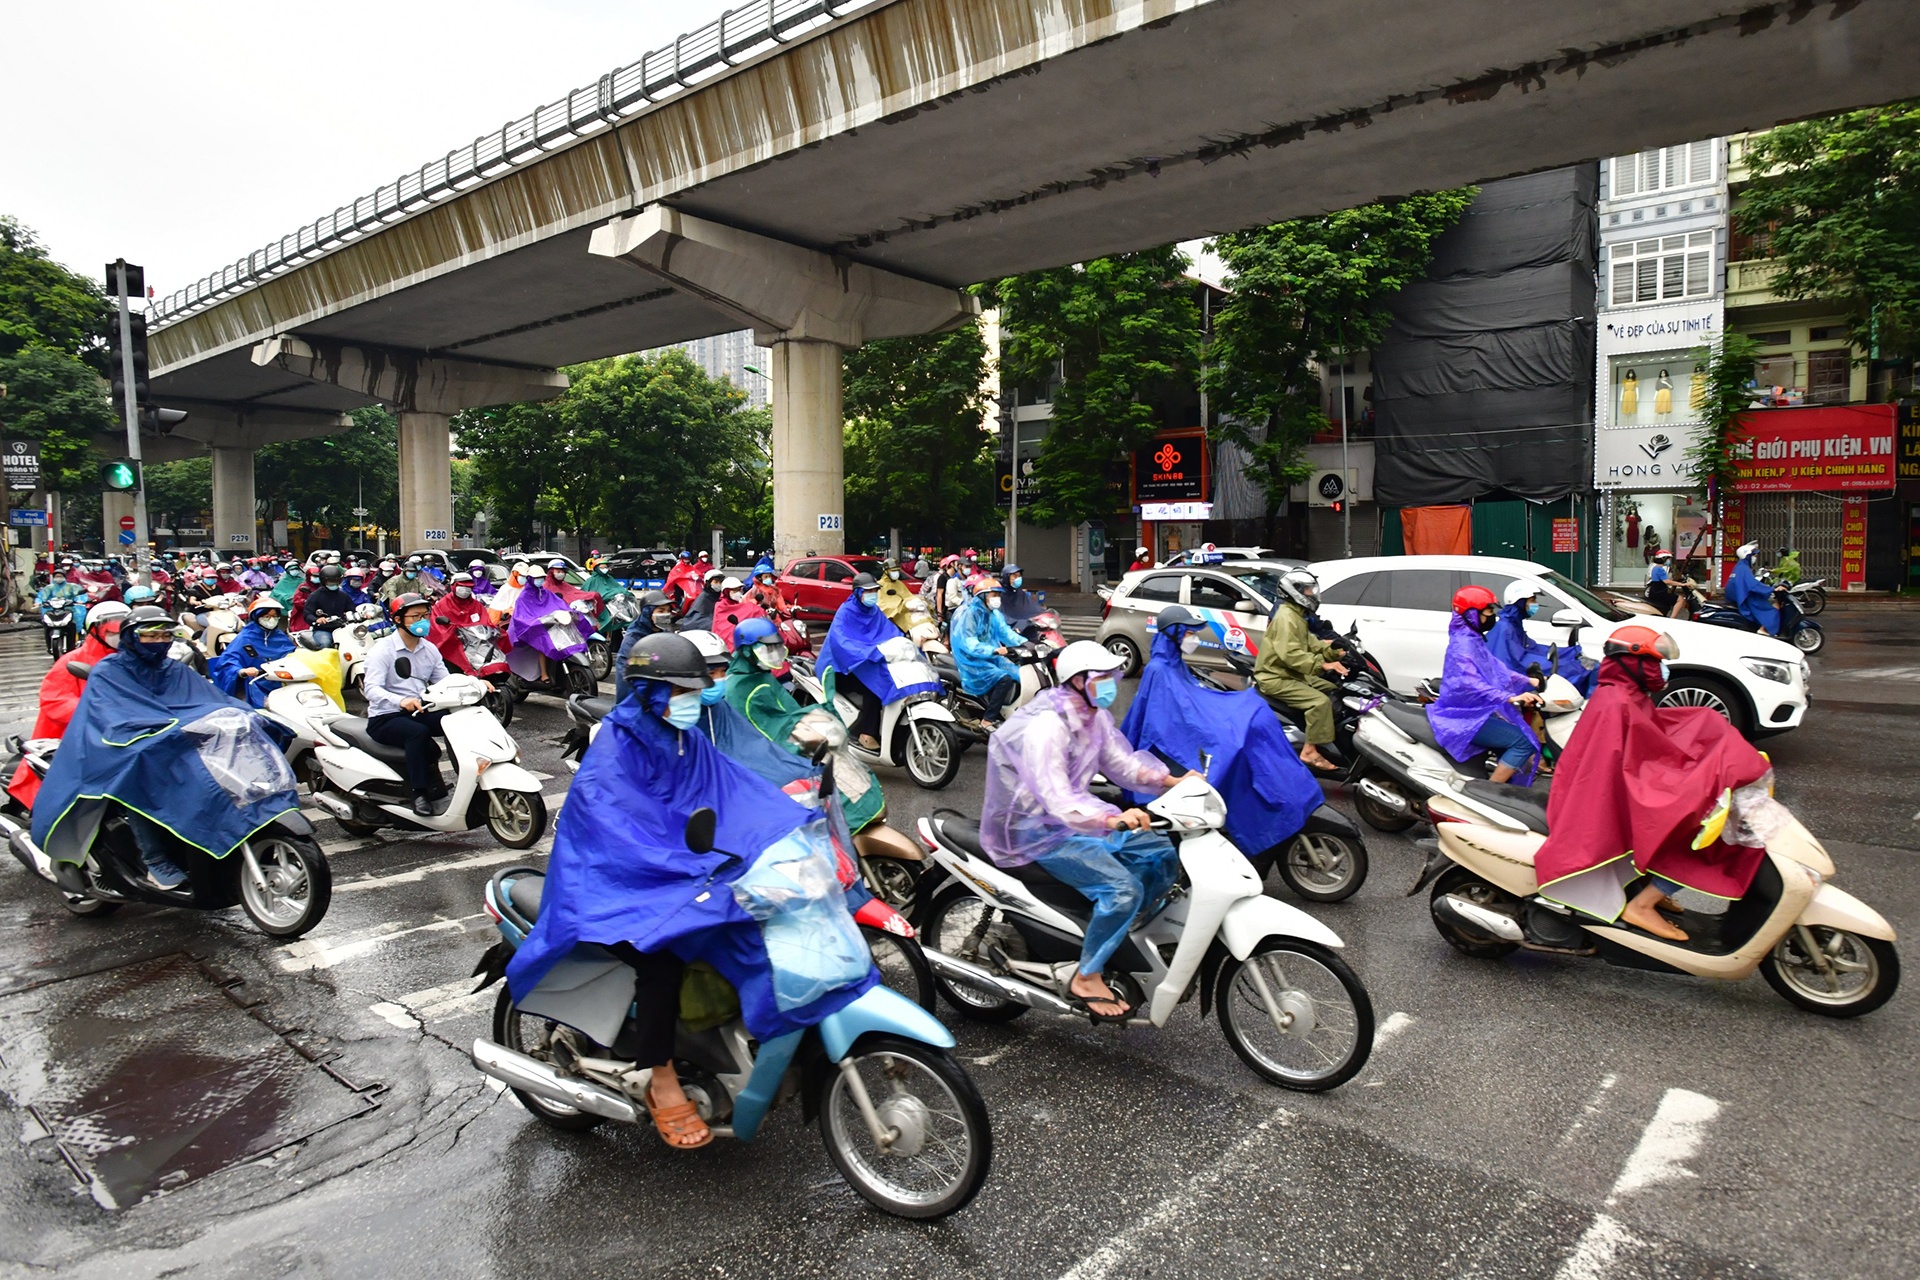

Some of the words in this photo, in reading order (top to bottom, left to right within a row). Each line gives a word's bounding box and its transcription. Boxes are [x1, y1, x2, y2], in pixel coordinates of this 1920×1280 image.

[1646, 320, 1666, 335] CỦA
[1667, 320, 1680, 335] SỰ
[1682, 319, 1700, 332] TINH
[1702, 313, 1713, 329] TẾ
[1757, 436, 1787, 460] GIỚI
[1790, 439, 1821, 461] PHỤ
[2, 455, 39, 466] HOTEL
[1609, 463, 1662, 477] HONG
[1800, 464, 1823, 479] KIỆN
[1825, 462, 1855, 477] CHÍNH
[231, 534, 249, 542] P279
[426, 530, 446, 540] P280
